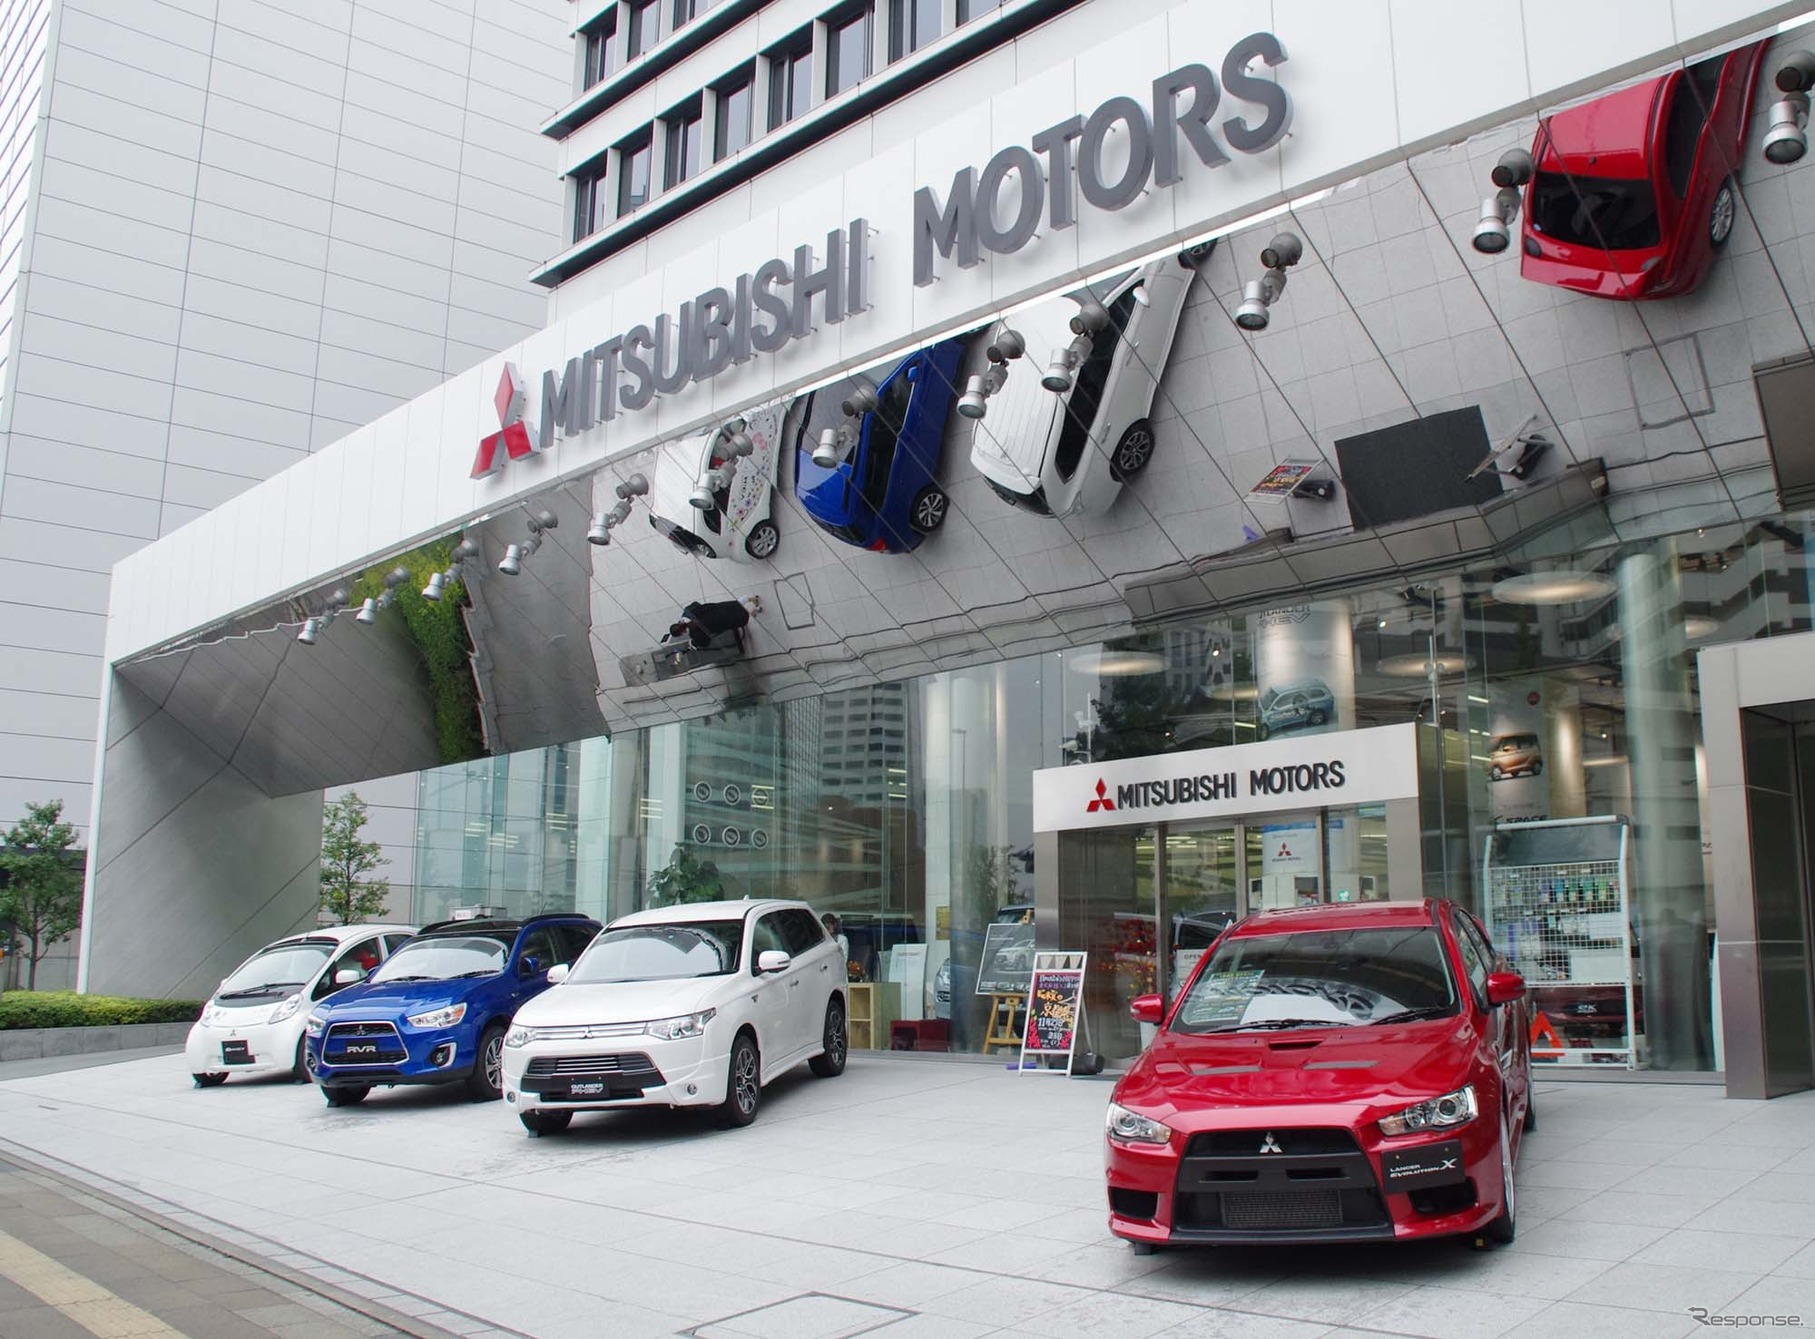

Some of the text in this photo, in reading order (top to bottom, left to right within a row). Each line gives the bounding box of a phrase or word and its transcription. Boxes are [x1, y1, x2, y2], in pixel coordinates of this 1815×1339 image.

[539, 31, 1293, 448] MITSUBISHI MOTORS
[1117, 760, 1345, 810] MITSUBISHI MOTORS
[346, 1045, 377, 1053] RVR
[1390, 1164, 1421, 1172] LANCER
[1390, 1158, 1458, 1178] EVOLUTION X
